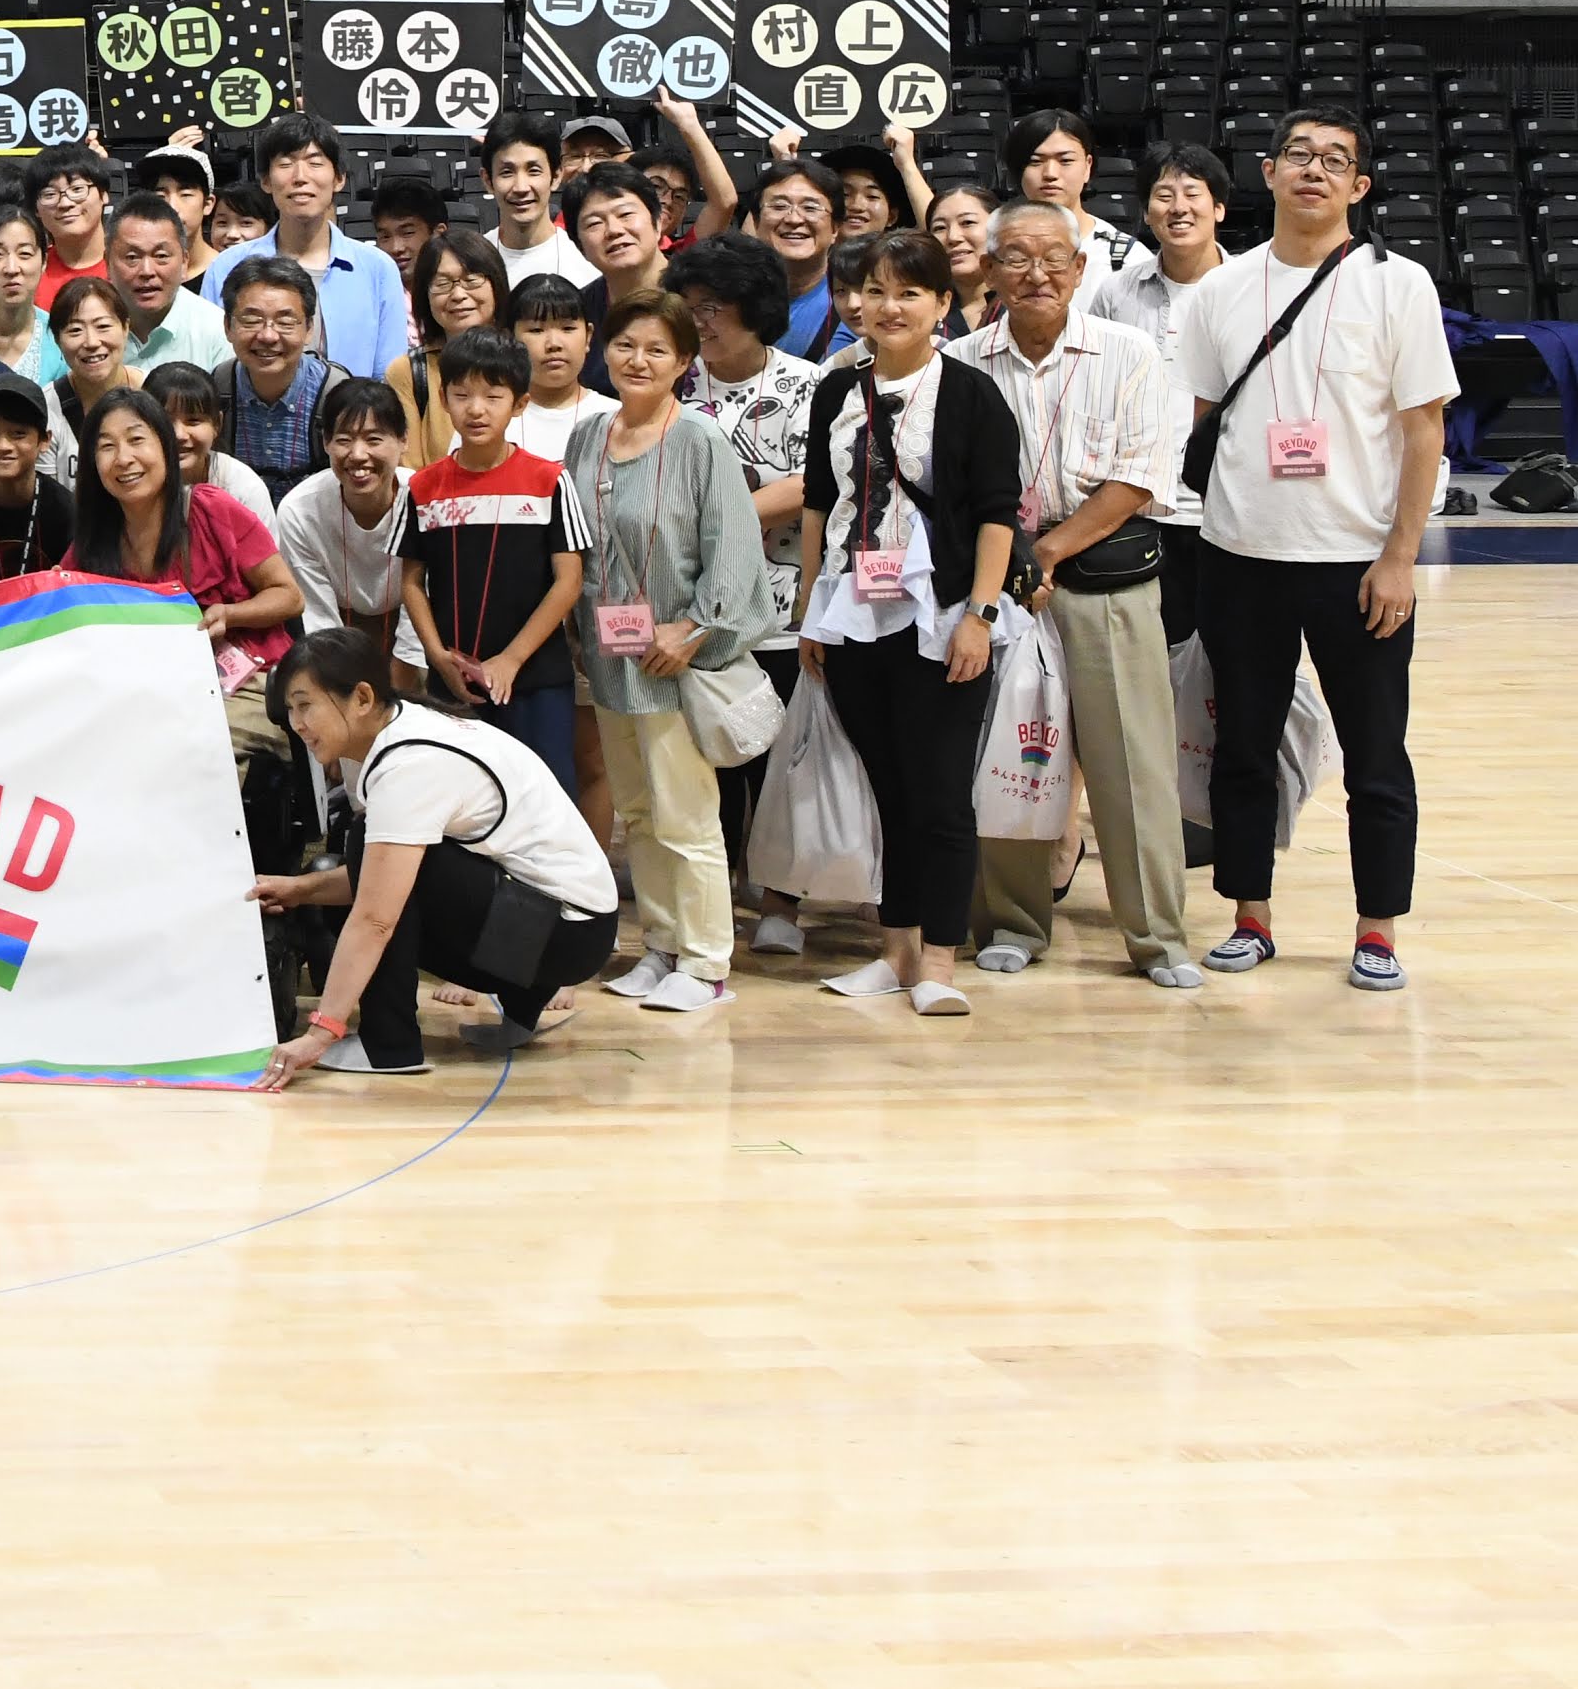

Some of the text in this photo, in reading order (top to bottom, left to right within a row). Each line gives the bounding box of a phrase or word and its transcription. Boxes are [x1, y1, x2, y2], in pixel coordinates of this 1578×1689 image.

[108, 16, 216, 62] 秋田
[332, 19, 451, 62] 藤本
[764, 12, 893, 56] 村上
[609, 40, 717, 85] 徹也
[221, 75, 263, 119] 啓
[369, 79, 491, 120] 怜央
[805, 71, 934, 117] 直広
[1278, 437, 1318, 452] BEYOND
[864, 561, 903, 576] BEYOND
[606, 615, 644, 630] BEYOND
